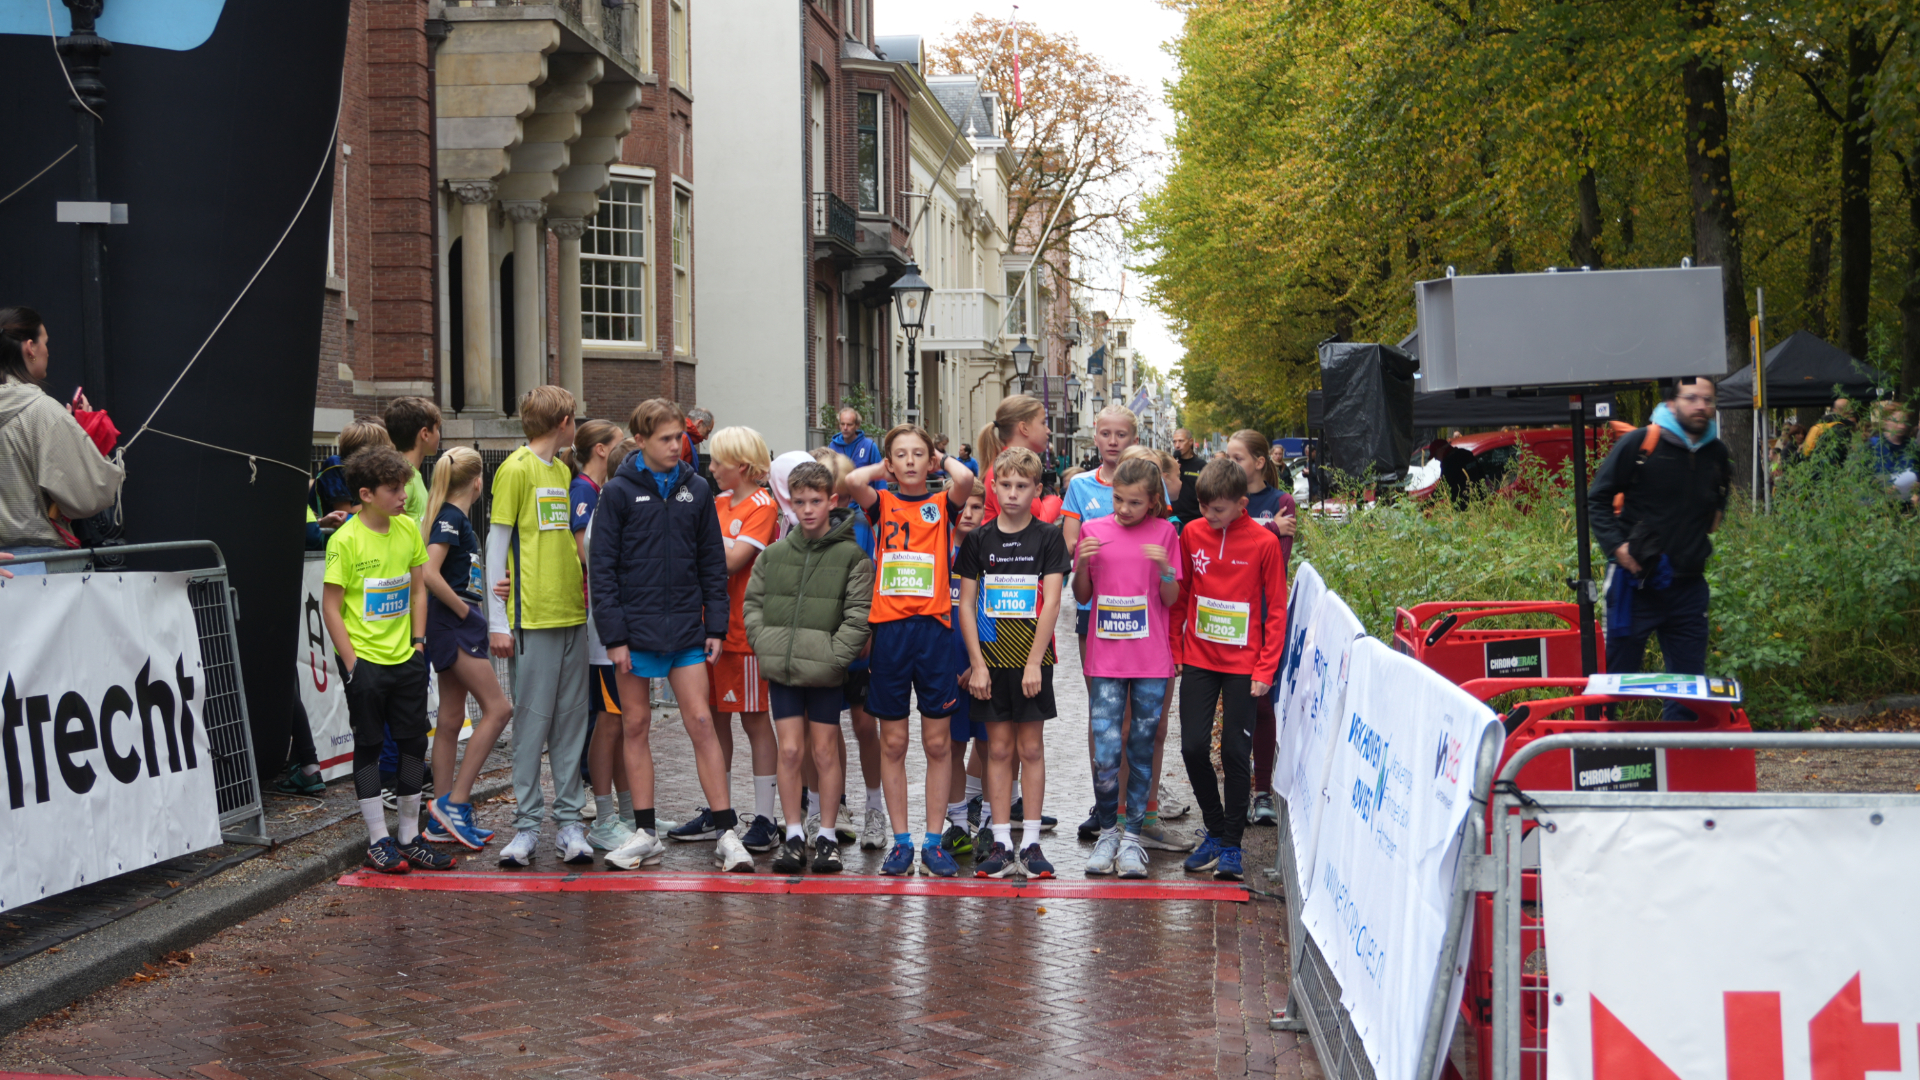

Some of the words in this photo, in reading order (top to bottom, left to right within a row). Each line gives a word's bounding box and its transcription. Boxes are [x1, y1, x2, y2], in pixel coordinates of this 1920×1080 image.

[885, 521, 909, 550] 21
[892, 553, 922, 561] Rabobank
[377, 577, 404, 586] Rabobank
[889, 576, 923, 588] J1204
[387, 593, 399, 601] REY
[1105, 597, 1135, 605] Rabobank
[378, 599, 404, 612] J1113
[994, 599, 1026, 610] J1100
[1206, 600, 1236, 610] Rabobank
[1110, 612, 1131, 620] MARE
[1209, 614, 1232, 624] TIMME
[1103, 619, 1139, 632] M1050
[1203, 622, 1236, 636] J1202
[2, 651, 198, 810] trecht
